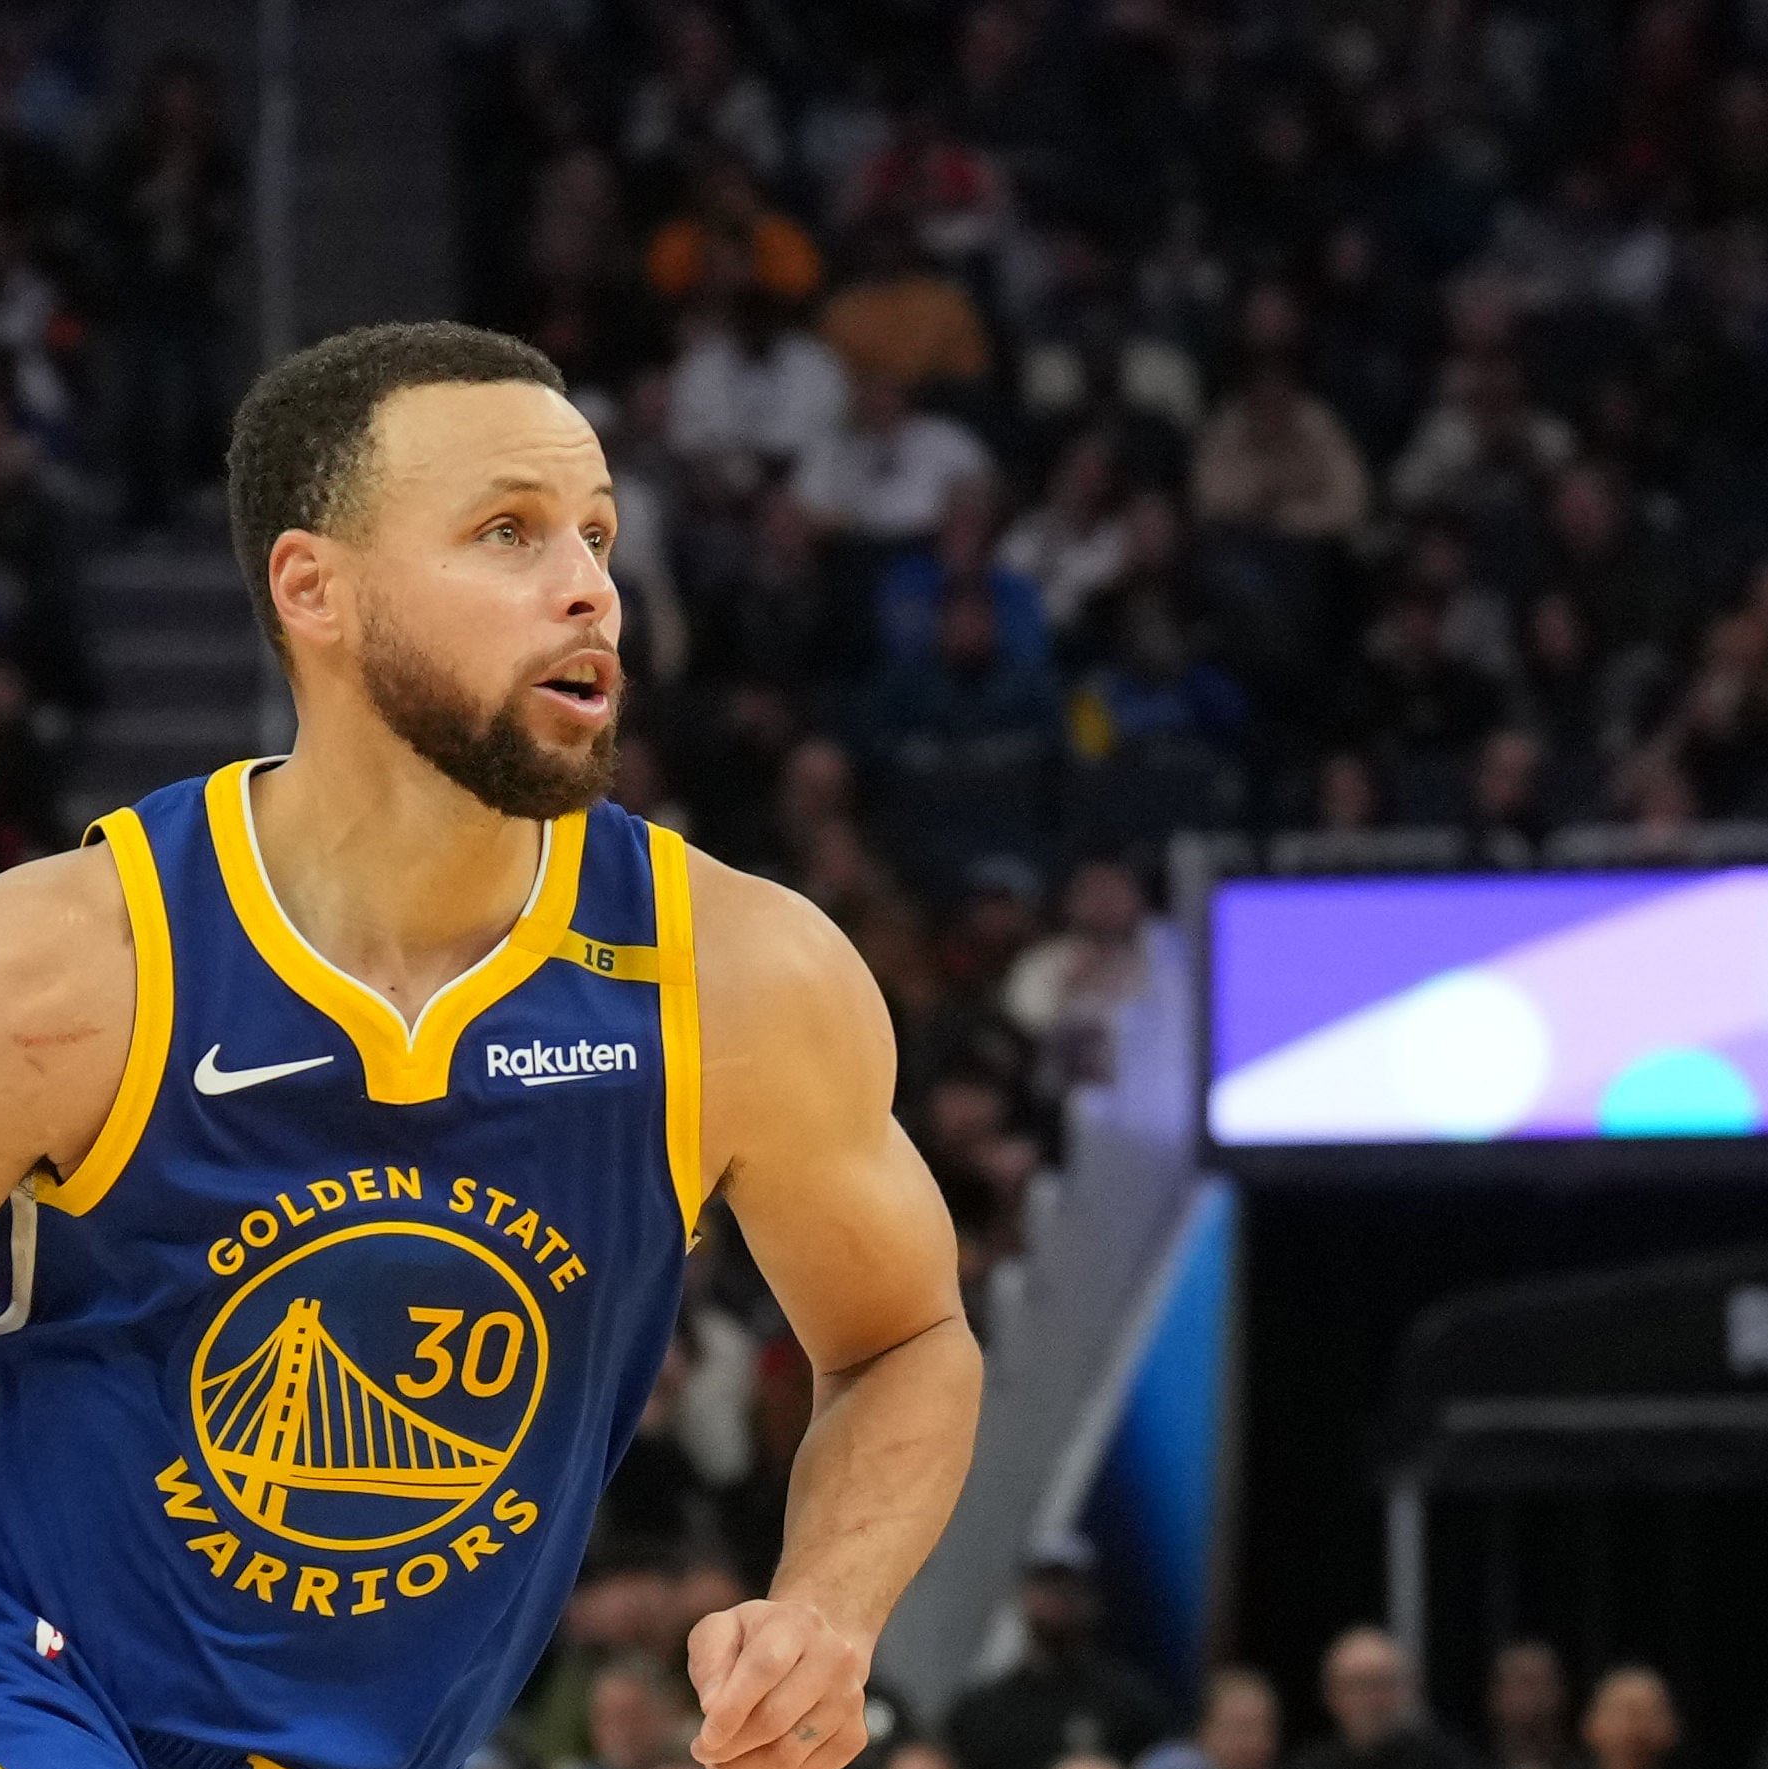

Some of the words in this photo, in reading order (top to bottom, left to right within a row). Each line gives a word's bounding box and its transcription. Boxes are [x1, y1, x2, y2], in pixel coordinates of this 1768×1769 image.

[582, 942, 615, 973] 16
[486, 1039, 638, 1079] Rakuten
[207, 1166, 423, 1277] GOLDEN
[448, 1176, 587, 1294] STATE
[394, 1305, 526, 1400] 30
[154, 1454, 539, 1617] WARRIORS
